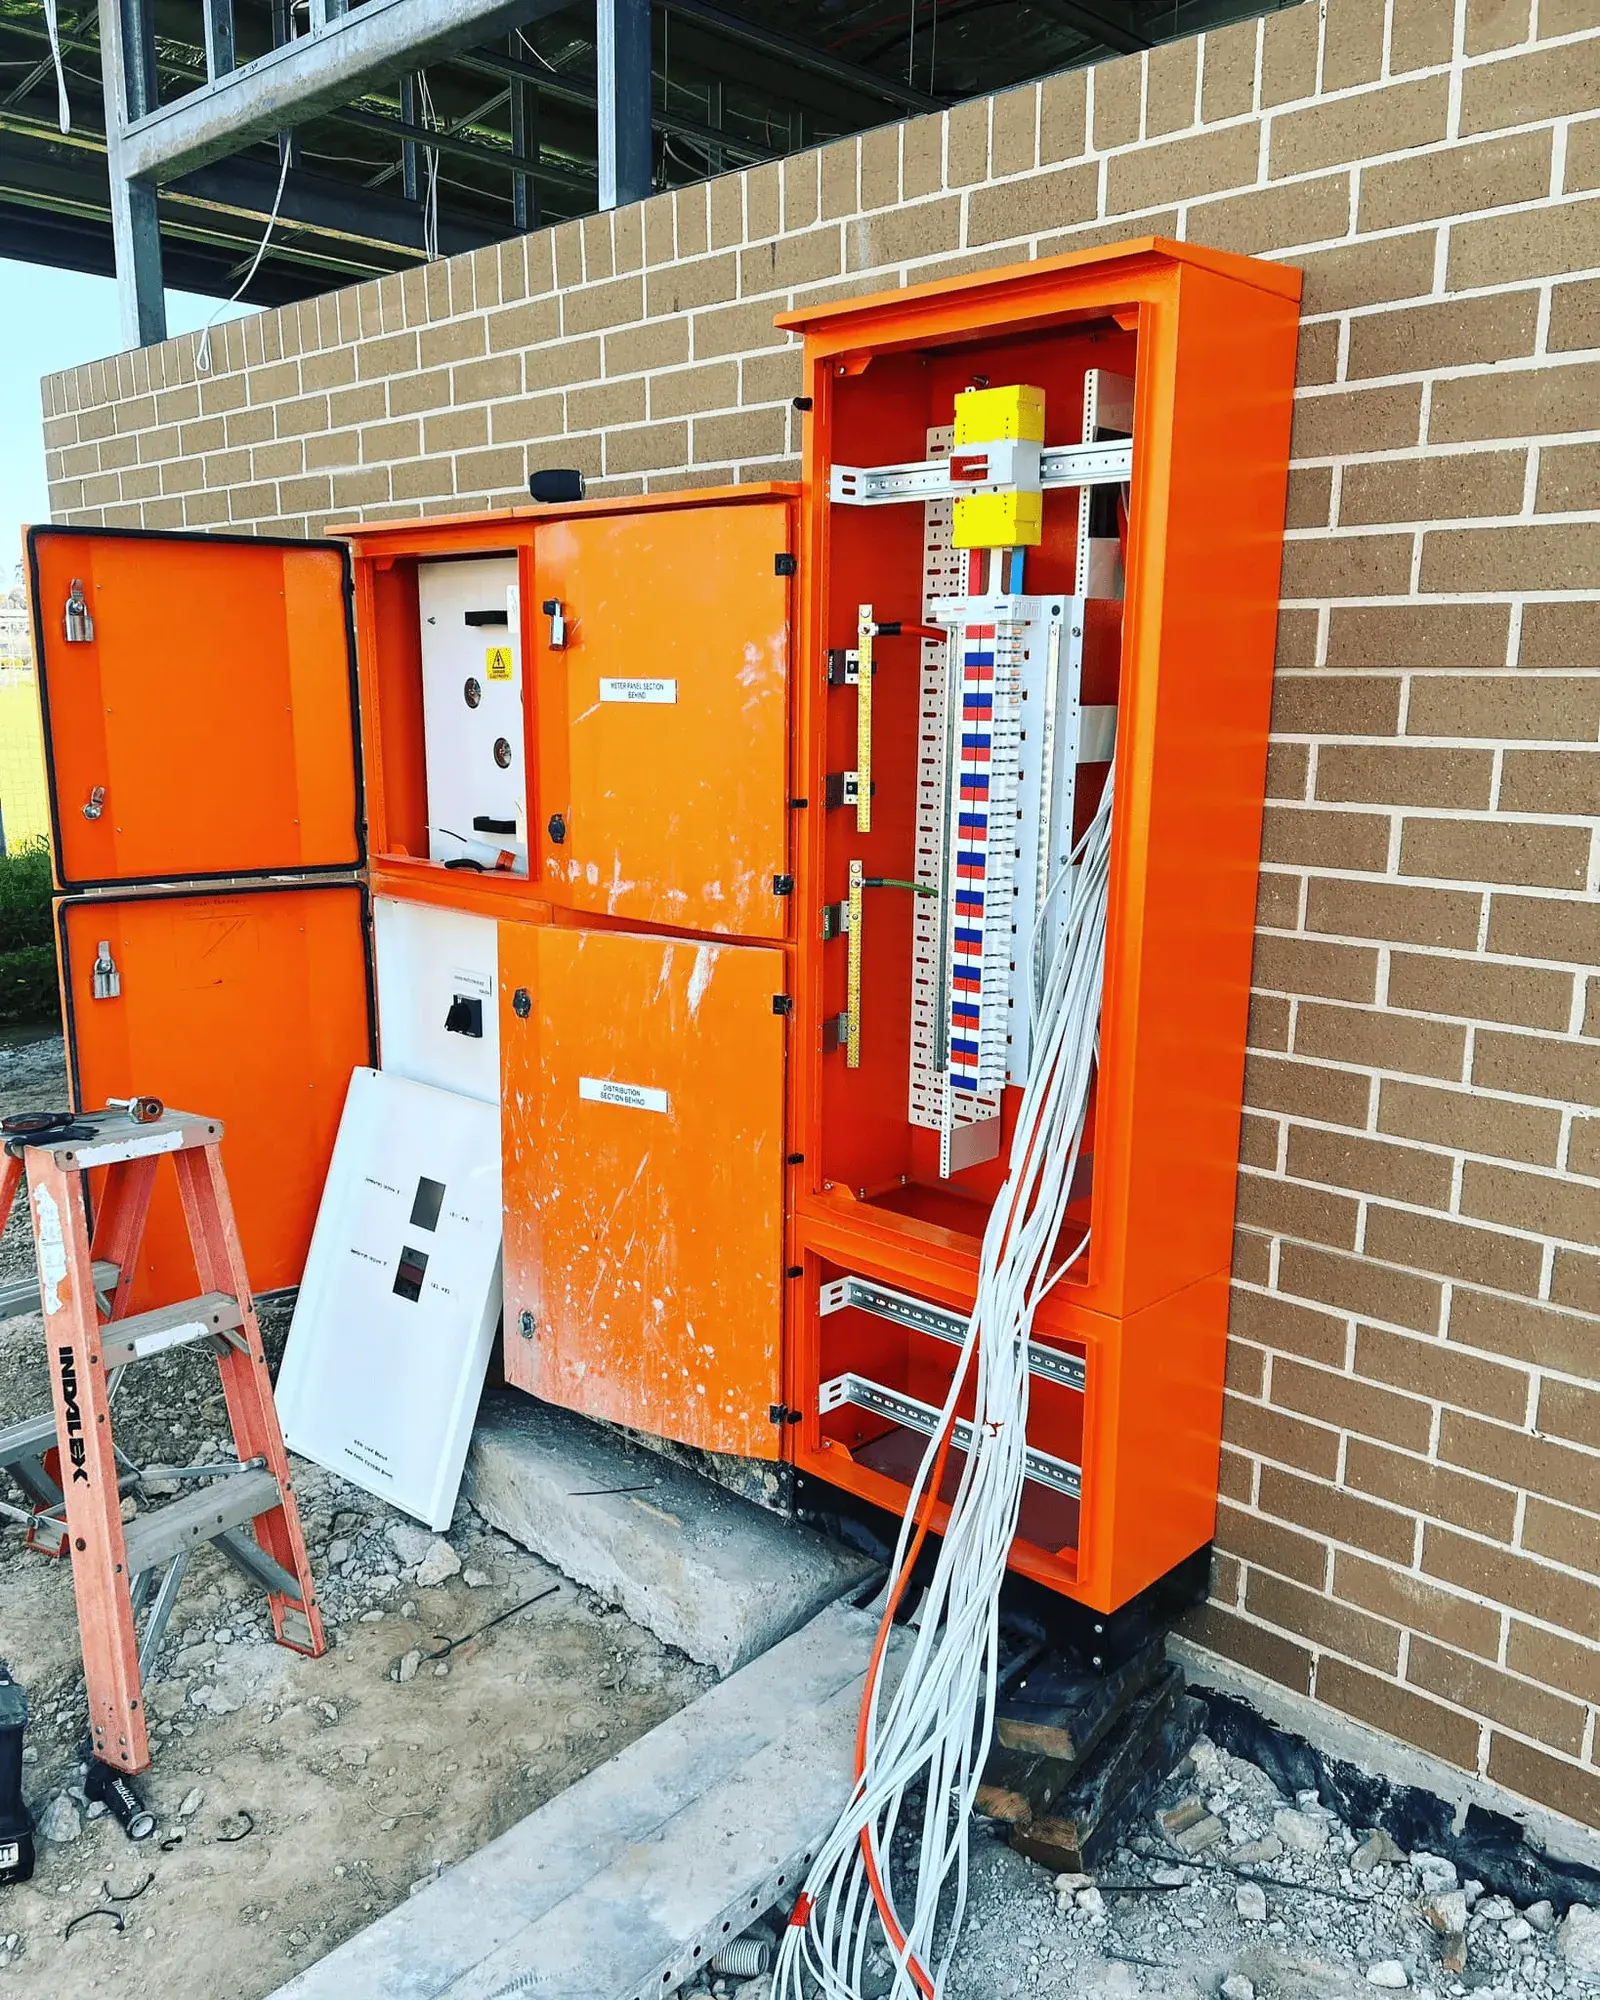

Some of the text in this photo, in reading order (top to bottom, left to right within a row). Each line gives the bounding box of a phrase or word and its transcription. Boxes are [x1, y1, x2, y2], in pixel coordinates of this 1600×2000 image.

[610, 682, 664, 691] METER PANEL SECTION
[628, 691, 646, 699] BEHIND
[603, 1084, 641, 1097] DISTRIBUTION
[600, 1092, 645, 1106] SECTION BEHIND
[59, 1346, 88, 1483] INDALEX
[111, 1777, 136, 1809] makita
